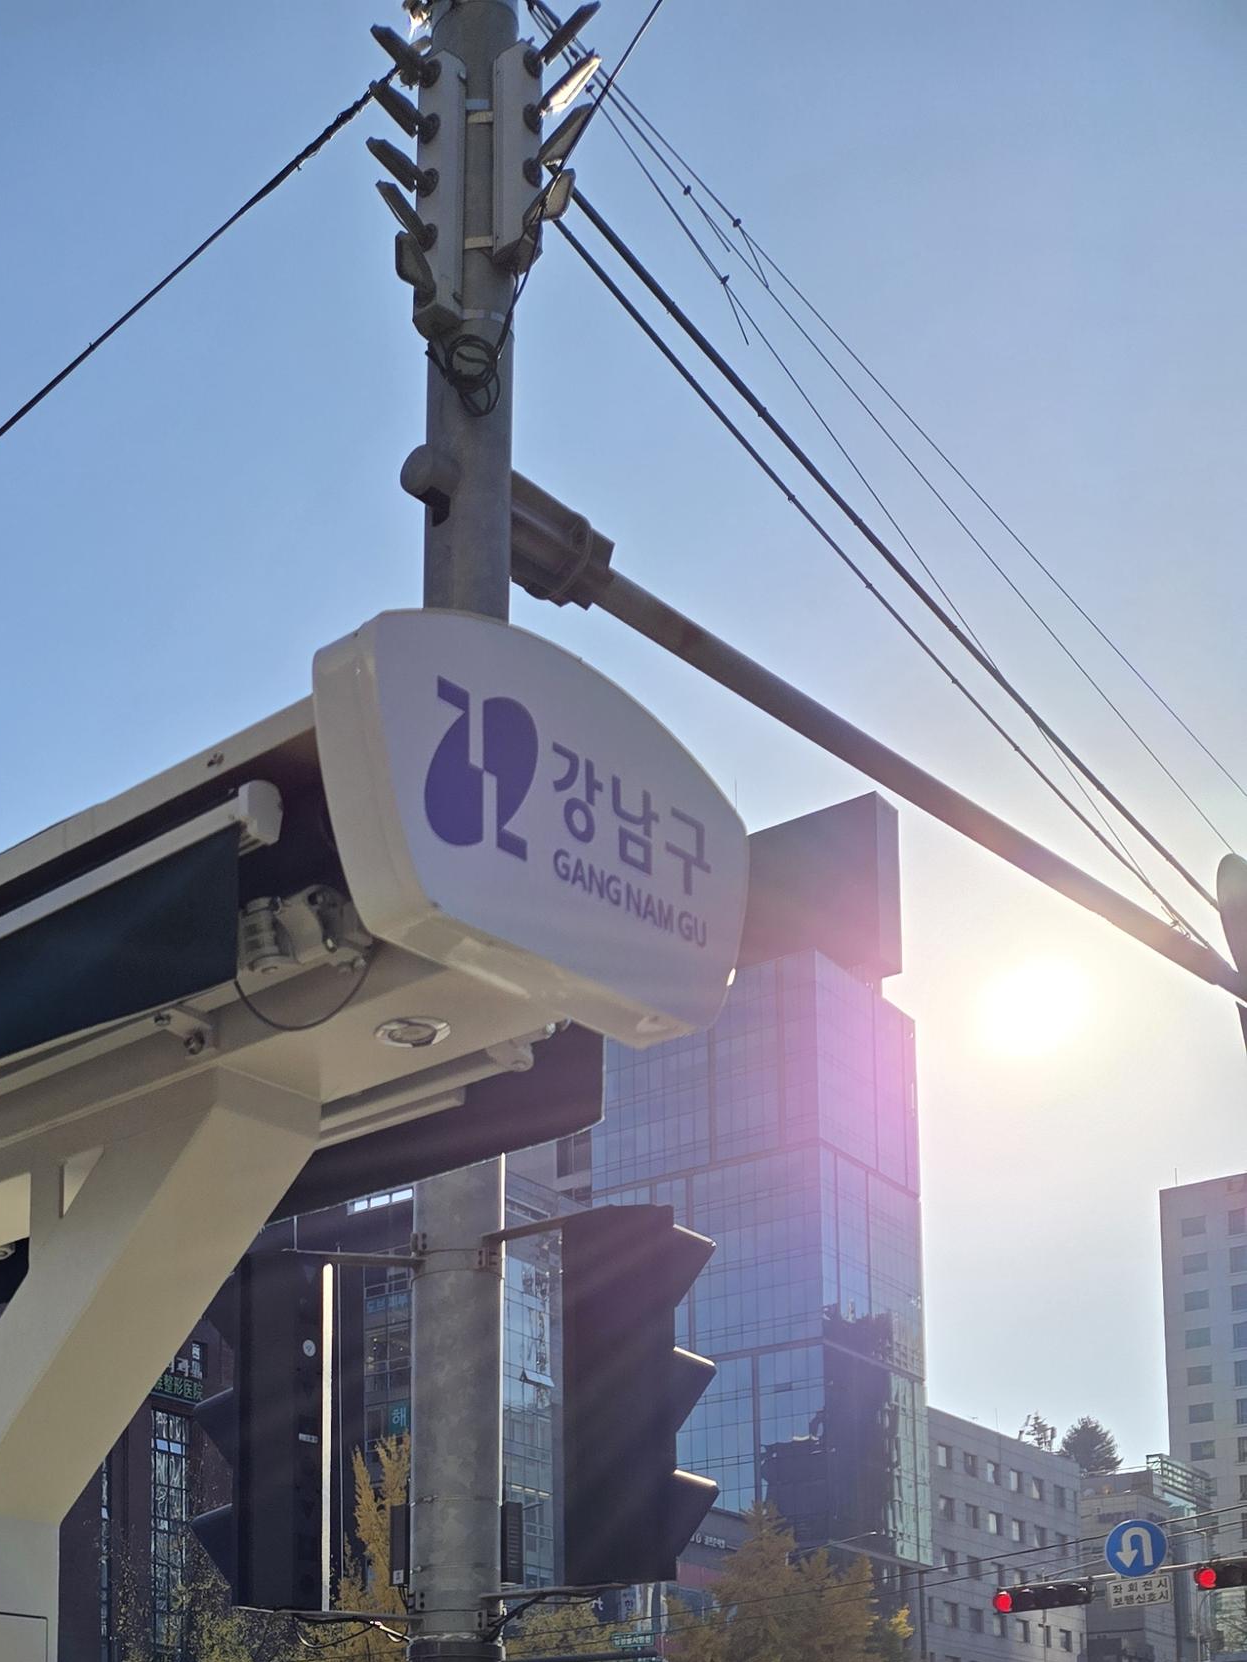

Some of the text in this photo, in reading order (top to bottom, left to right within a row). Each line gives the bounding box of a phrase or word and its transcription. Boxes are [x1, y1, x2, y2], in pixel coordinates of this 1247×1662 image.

[553, 741, 711, 896] 강남구
[553, 849, 707, 948] GANG NAM GU
[1113, 1590, 1169, 1606] 보행신호시
